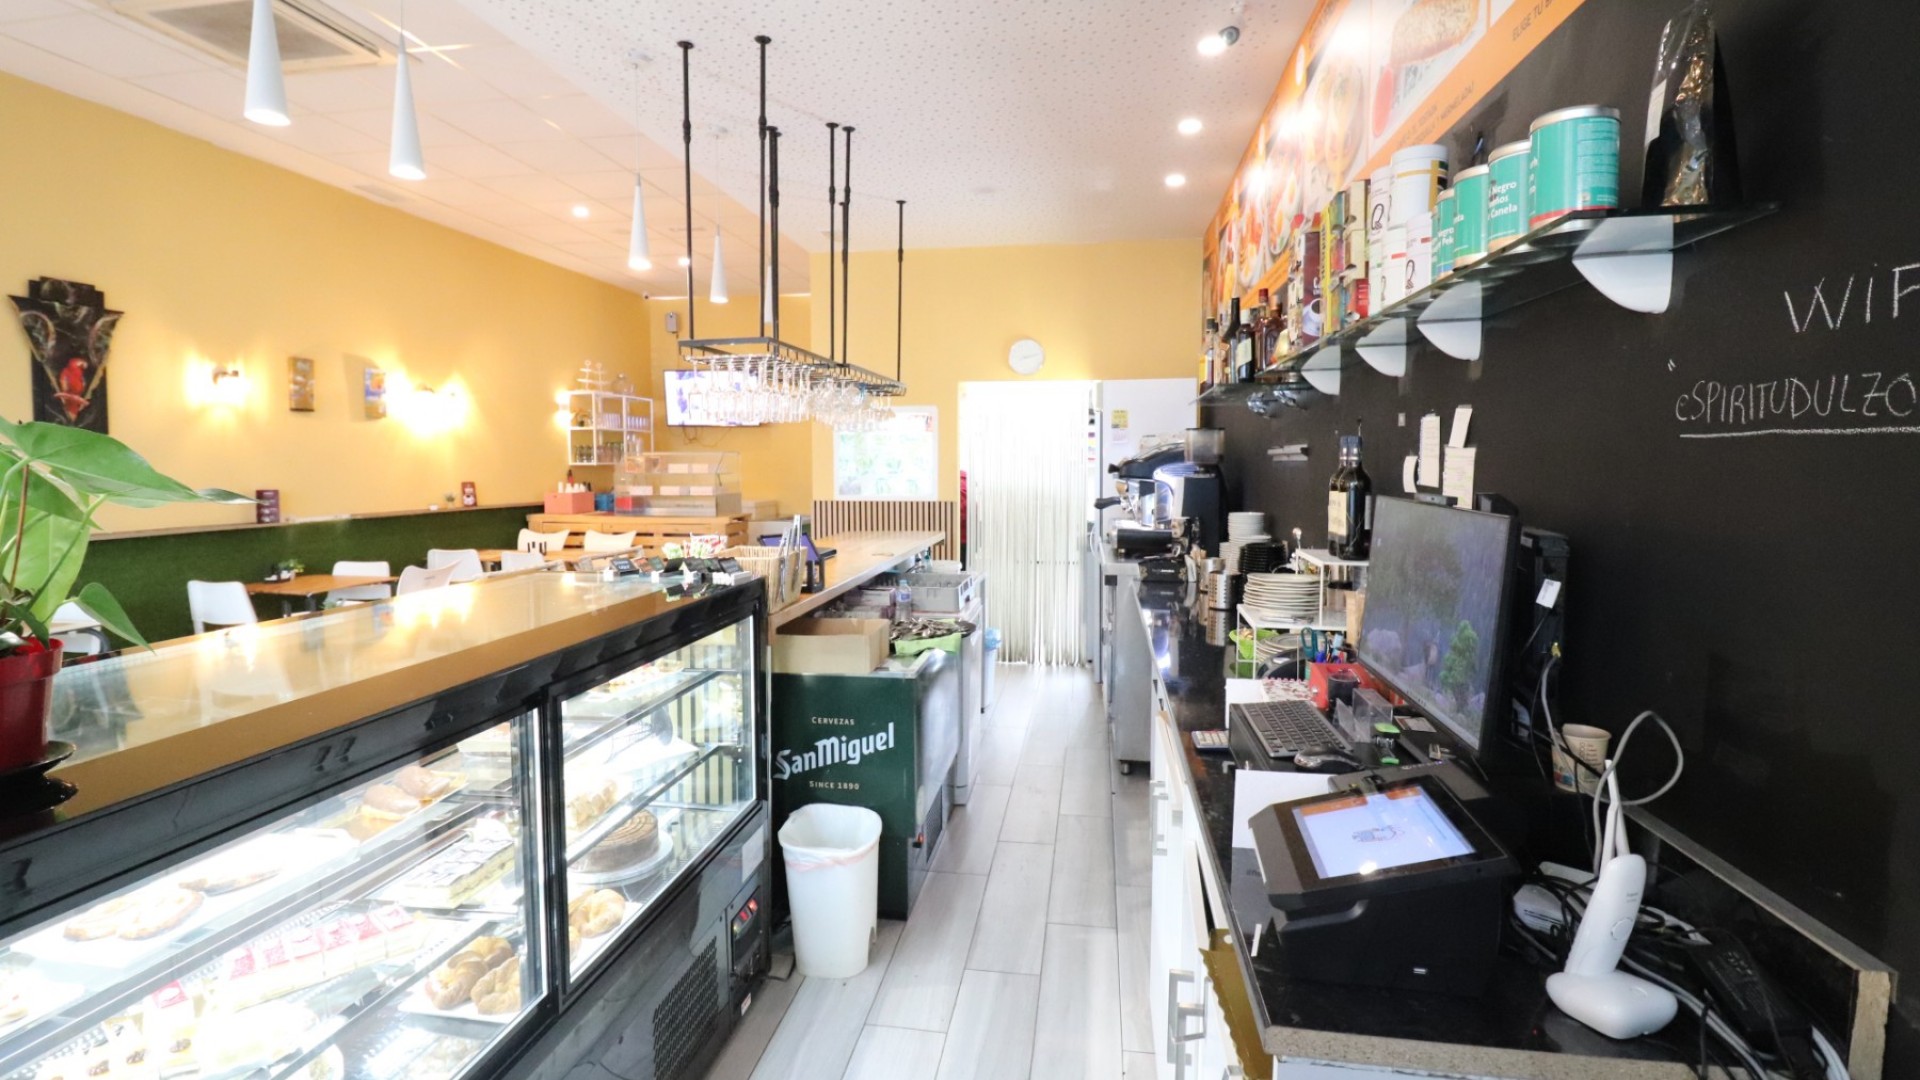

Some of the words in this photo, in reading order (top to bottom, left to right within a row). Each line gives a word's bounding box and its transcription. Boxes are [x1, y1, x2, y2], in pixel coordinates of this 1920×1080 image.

[1490, 203, 1517, 219] Canela
[811, 716, 855, 726] CERVEZAS
[773, 722, 895, 780] SanMiguel
[809, 780, 835, 789] SINCE
[837, 782, 860, 790] 1890
